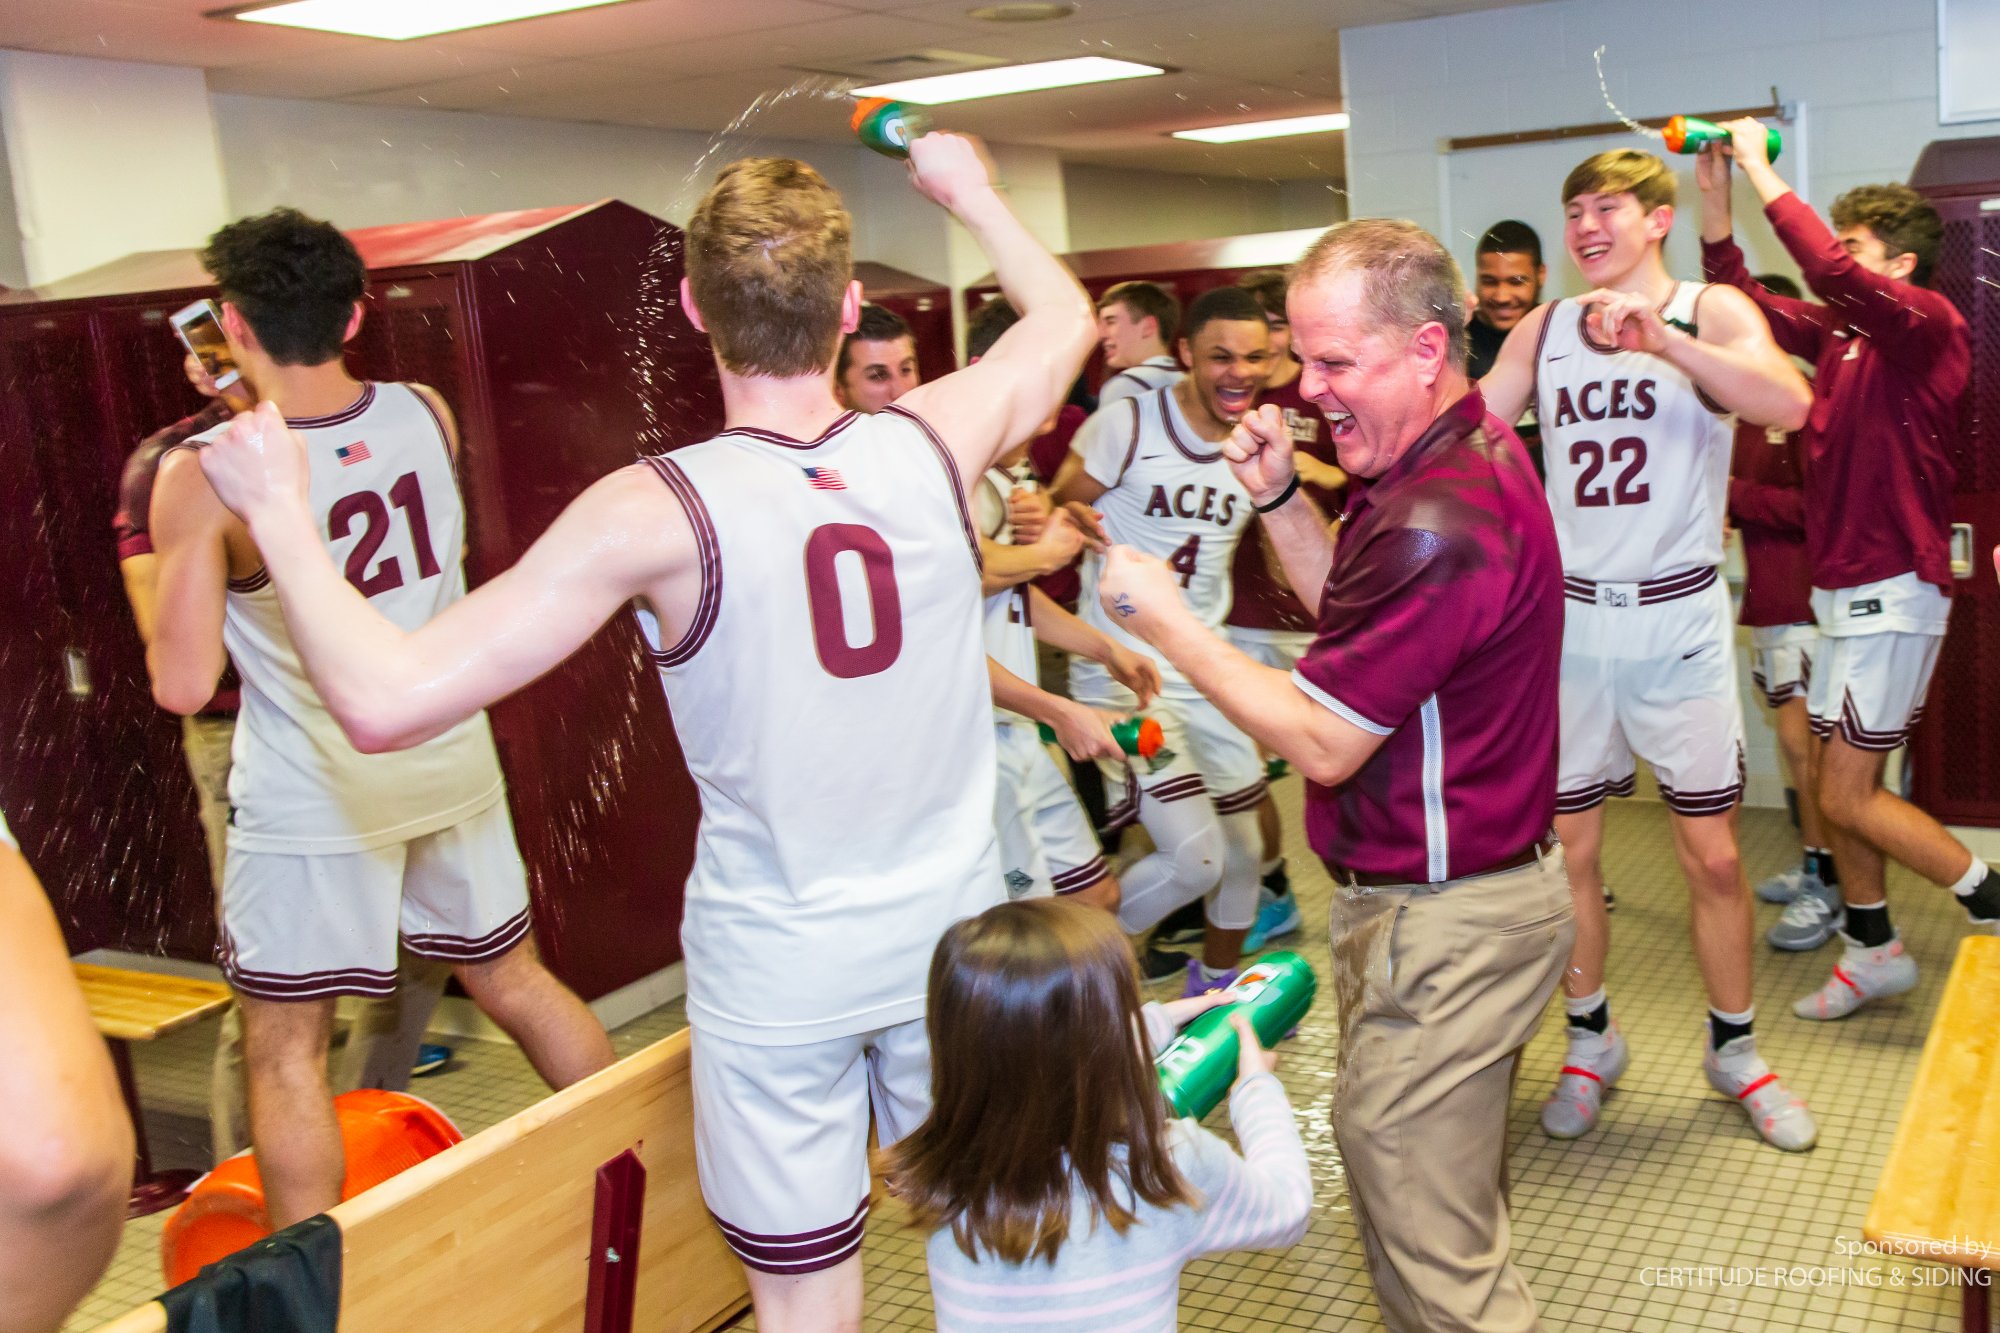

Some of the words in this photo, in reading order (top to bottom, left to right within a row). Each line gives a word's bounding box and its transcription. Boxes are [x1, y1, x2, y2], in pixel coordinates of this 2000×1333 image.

[1555, 378, 1656, 428] ACES
[1569, 436, 1650, 507] 22
[327, 470, 442, 599] 21
[1143, 484, 1237, 526] ACES
[1167, 533, 1201, 589] 4
[803, 522, 903, 678] 0
